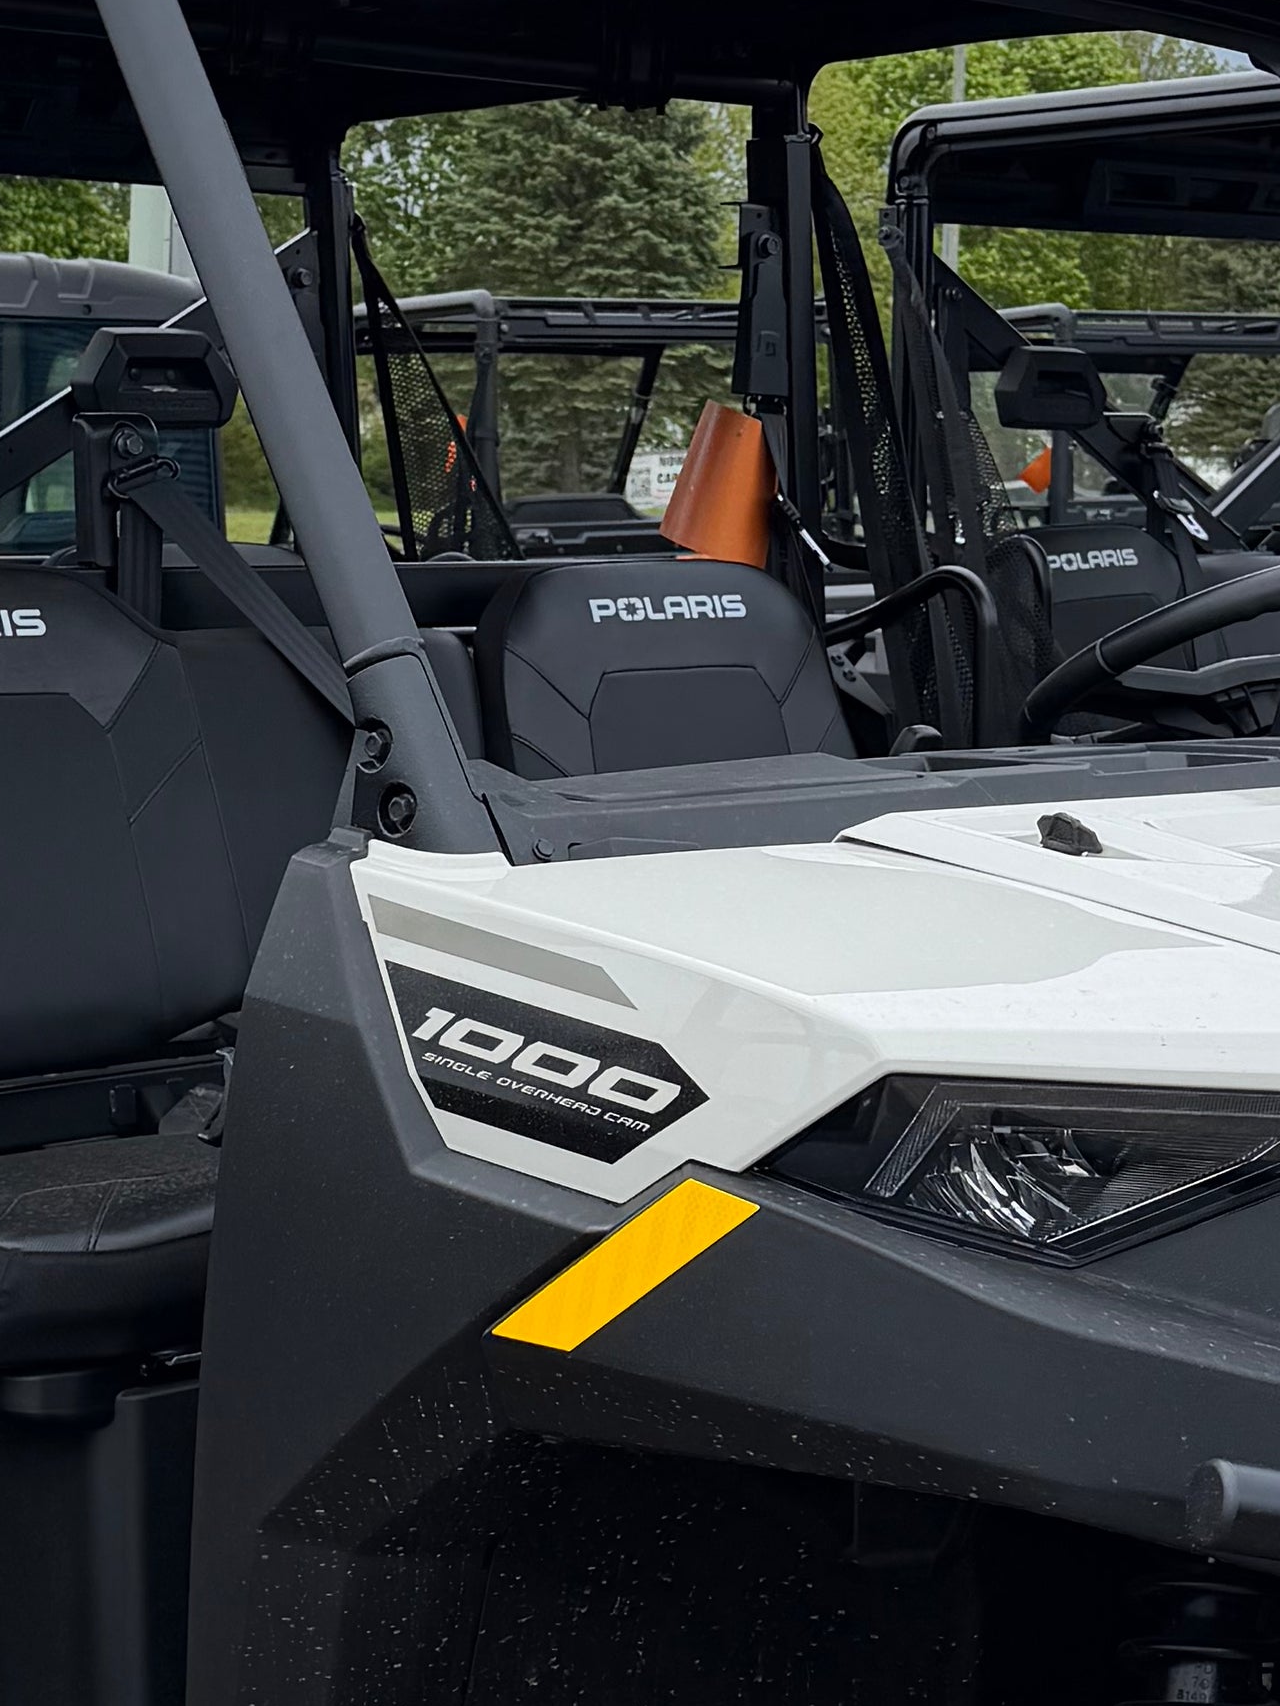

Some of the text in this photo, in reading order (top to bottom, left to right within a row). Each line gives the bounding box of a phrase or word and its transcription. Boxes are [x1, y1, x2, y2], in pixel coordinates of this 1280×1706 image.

[1046, 548, 1139, 572] POLARIS
[588, 594, 747, 623] POLARIS
[411, 1006, 682, 1115] 1000
[421, 1051, 651, 1133] SINGLE OVERHEAD CAM
